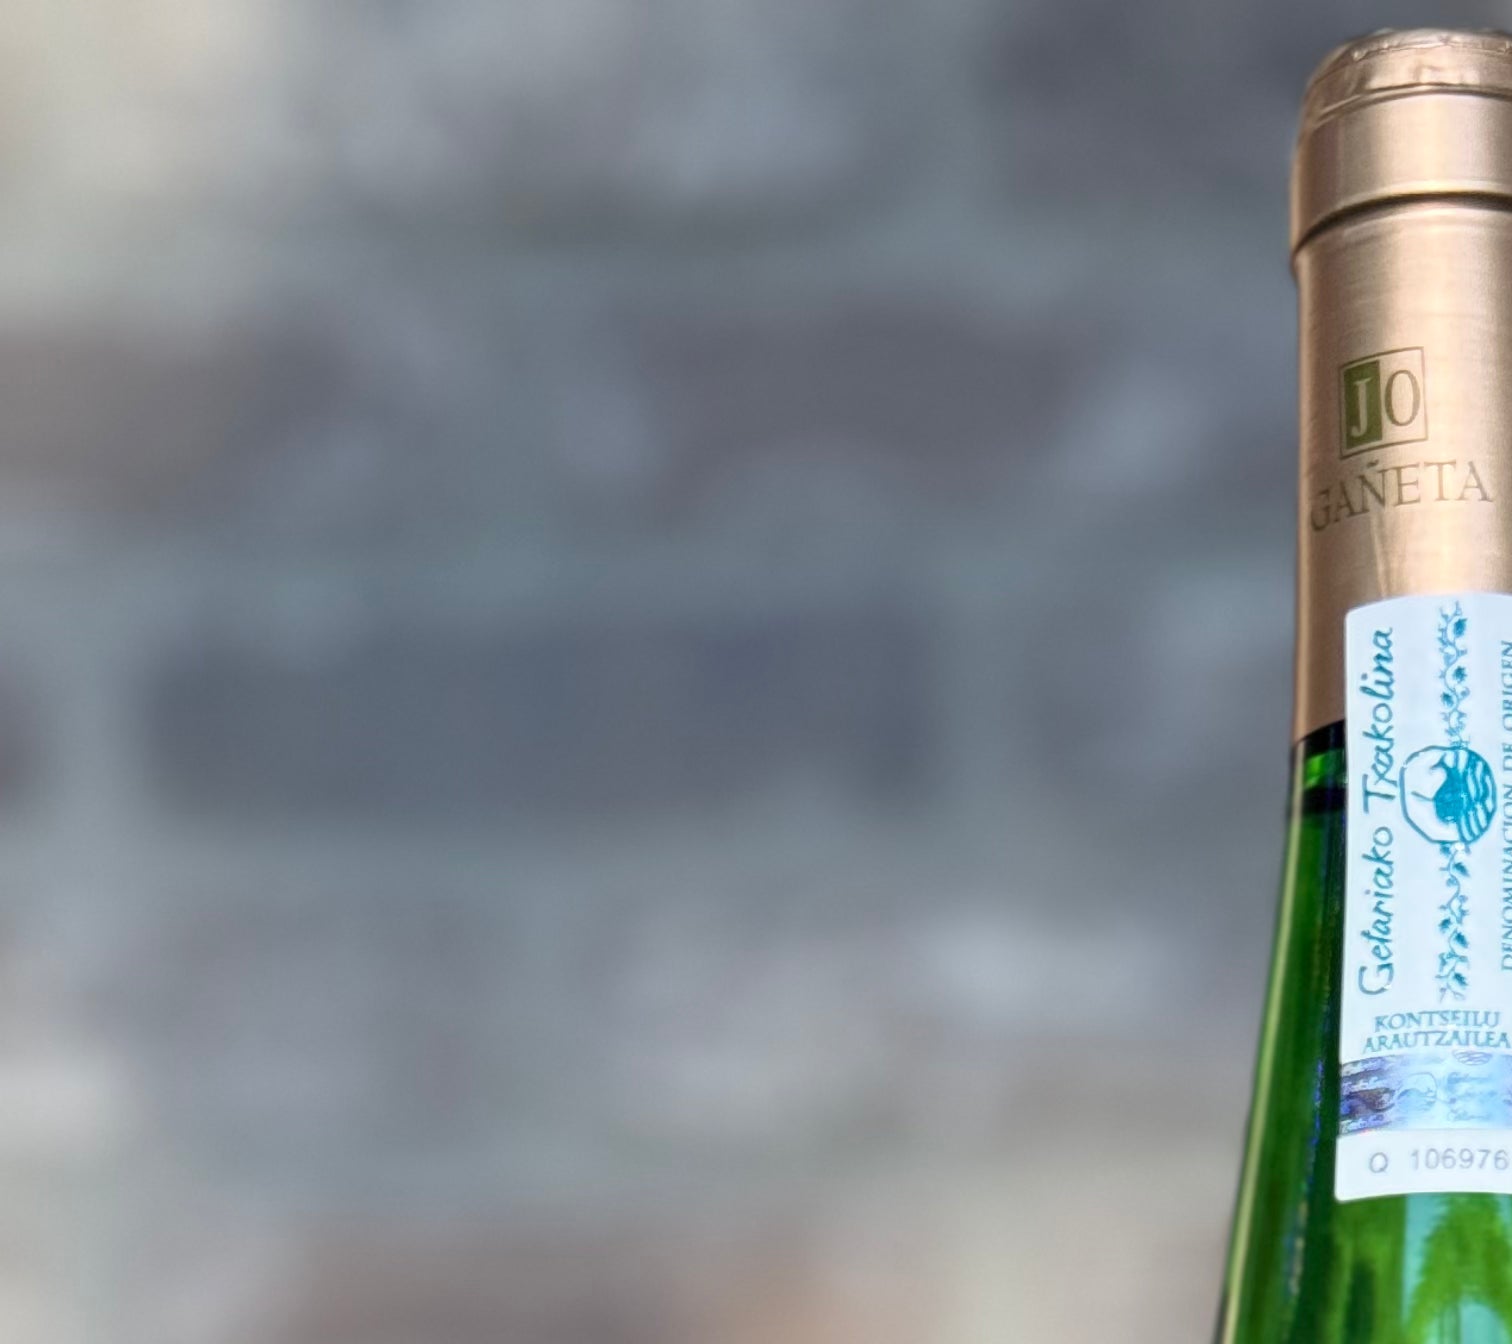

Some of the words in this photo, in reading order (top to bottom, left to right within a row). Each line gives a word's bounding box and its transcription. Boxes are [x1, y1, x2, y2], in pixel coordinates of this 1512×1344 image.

[1310, 459, 1493, 532] GAÑETA
[1359, 626, 1397, 814] Txakolina
[1358, 826, 1394, 995] Getariako
[1363, 1031, 1511, 1053] ARAUTZAILEA
[1374, 1010, 1501, 1032] KONTSEILU
[1410, 1148, 1510, 1171] 106976
